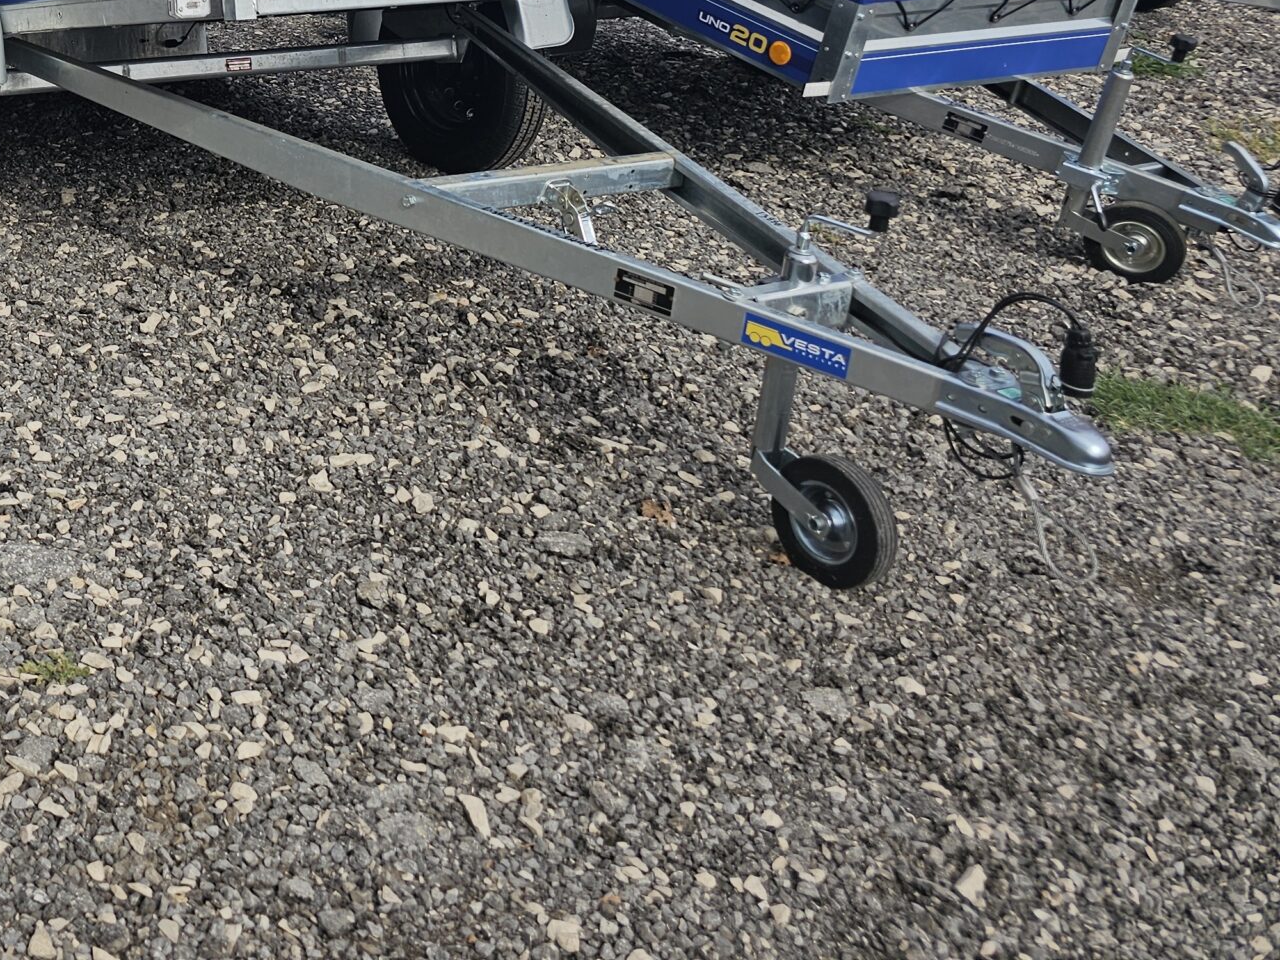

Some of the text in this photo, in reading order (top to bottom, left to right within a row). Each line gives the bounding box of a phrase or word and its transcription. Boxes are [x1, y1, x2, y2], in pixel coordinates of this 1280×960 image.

[698, 11, 768, 54] UNO 20
[780, 333, 846, 366] VESTA
